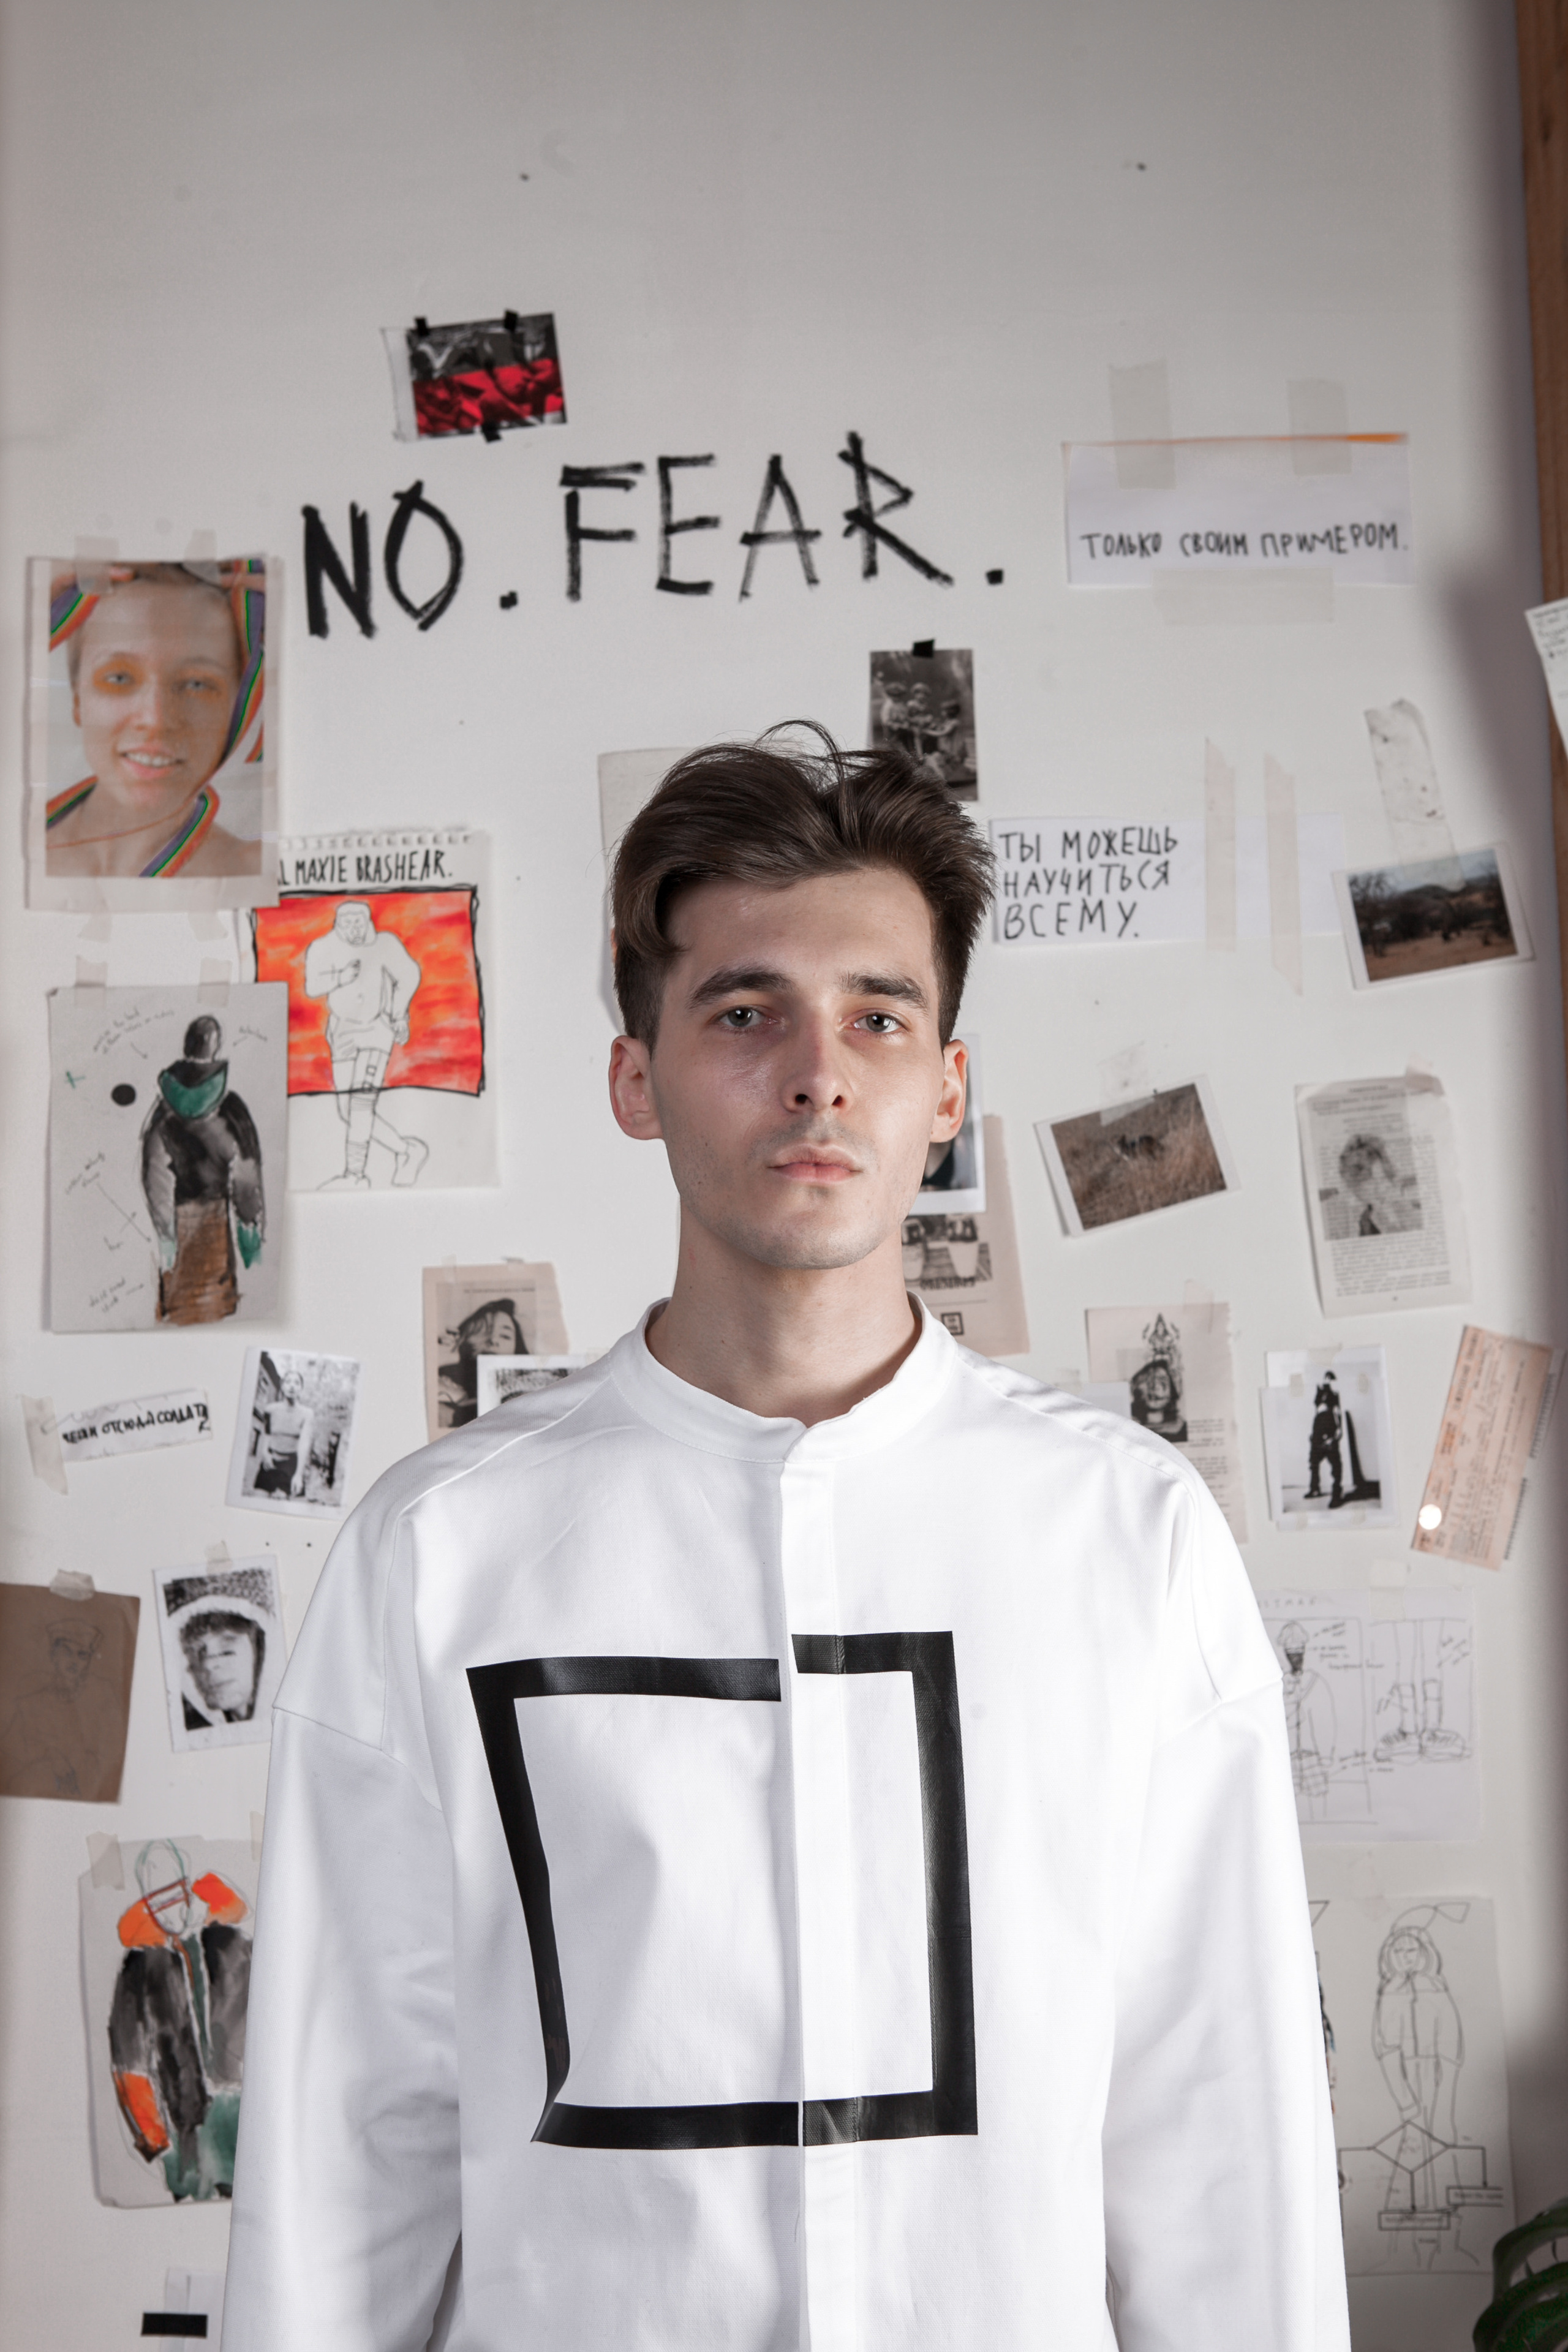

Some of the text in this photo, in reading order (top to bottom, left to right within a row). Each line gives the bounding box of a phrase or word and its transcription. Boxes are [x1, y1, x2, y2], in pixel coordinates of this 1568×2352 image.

[559, 431, 1005, 603] FEAR.
[1079, 532, 1163, 559] ТОЛЬКО
[1179, 530, 1248, 558] СВОИМ
[998, 826, 1178, 862] ТЫ МОЖЕШЬ
[295, 854, 348, 886] MAXIE
[356, 849, 454, 883] BRASHEAR.
[1003, 859, 1169, 898] НАУЧИТЬСЯ
[1003, 898, 1140, 941] ВСЕМУ.
